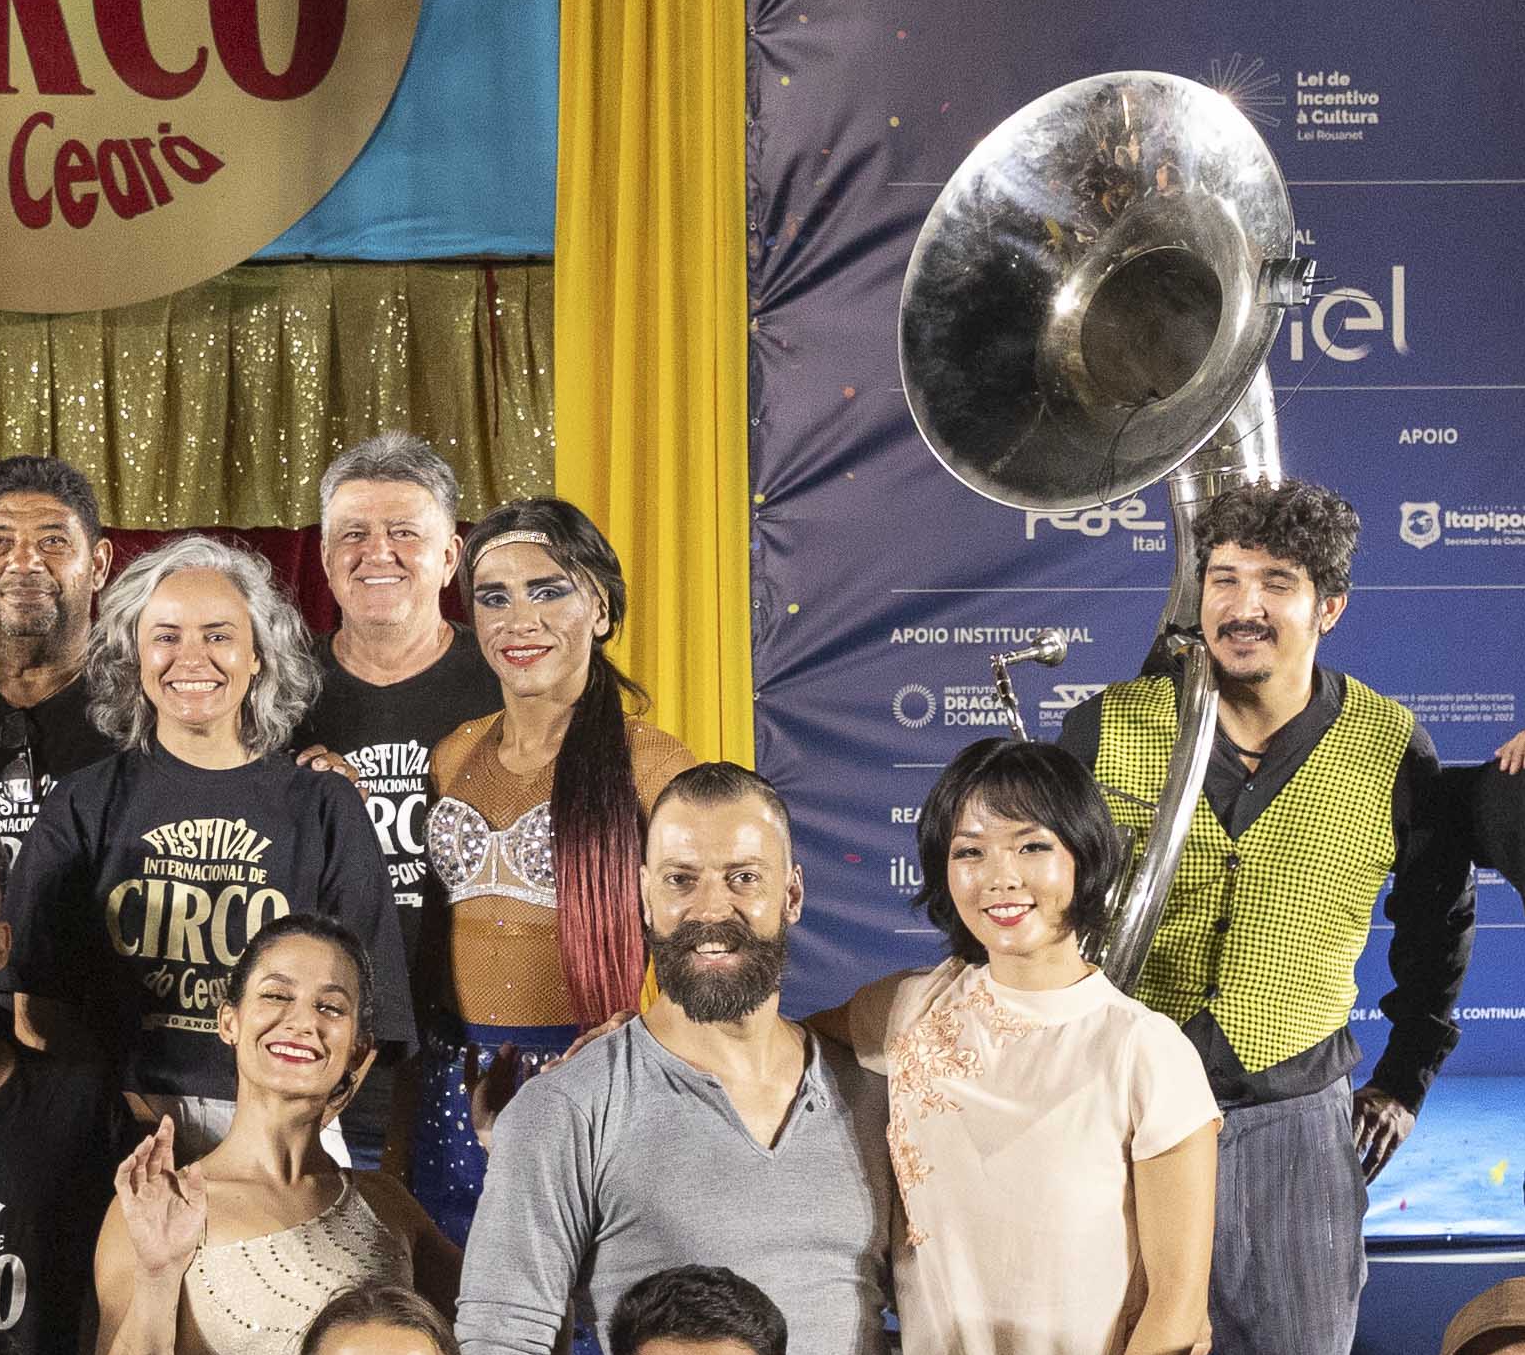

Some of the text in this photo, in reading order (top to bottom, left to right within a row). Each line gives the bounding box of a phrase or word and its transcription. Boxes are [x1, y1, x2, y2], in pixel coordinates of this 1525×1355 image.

[1297, 71, 1350, 86] Lei de
[1297, 90, 1379, 105] Incentivo
[1297, 109, 1379, 124] à Cultura
[1298, 130, 1314, 141] Lei
[8, 111, 225, 230] Ceará
[1399, 428, 1458, 444] APOIO
[1133, 535, 1166, 551] Itaú
[891, 627, 1093, 644] APOIO INSTITUCNAL
[141, 818, 272, 863] FESTIVAL
[143, 856, 267, 884] INTERNACIONAL DE
[106, 879, 290, 967] CIRCO
[144, 964, 174, 998] do
